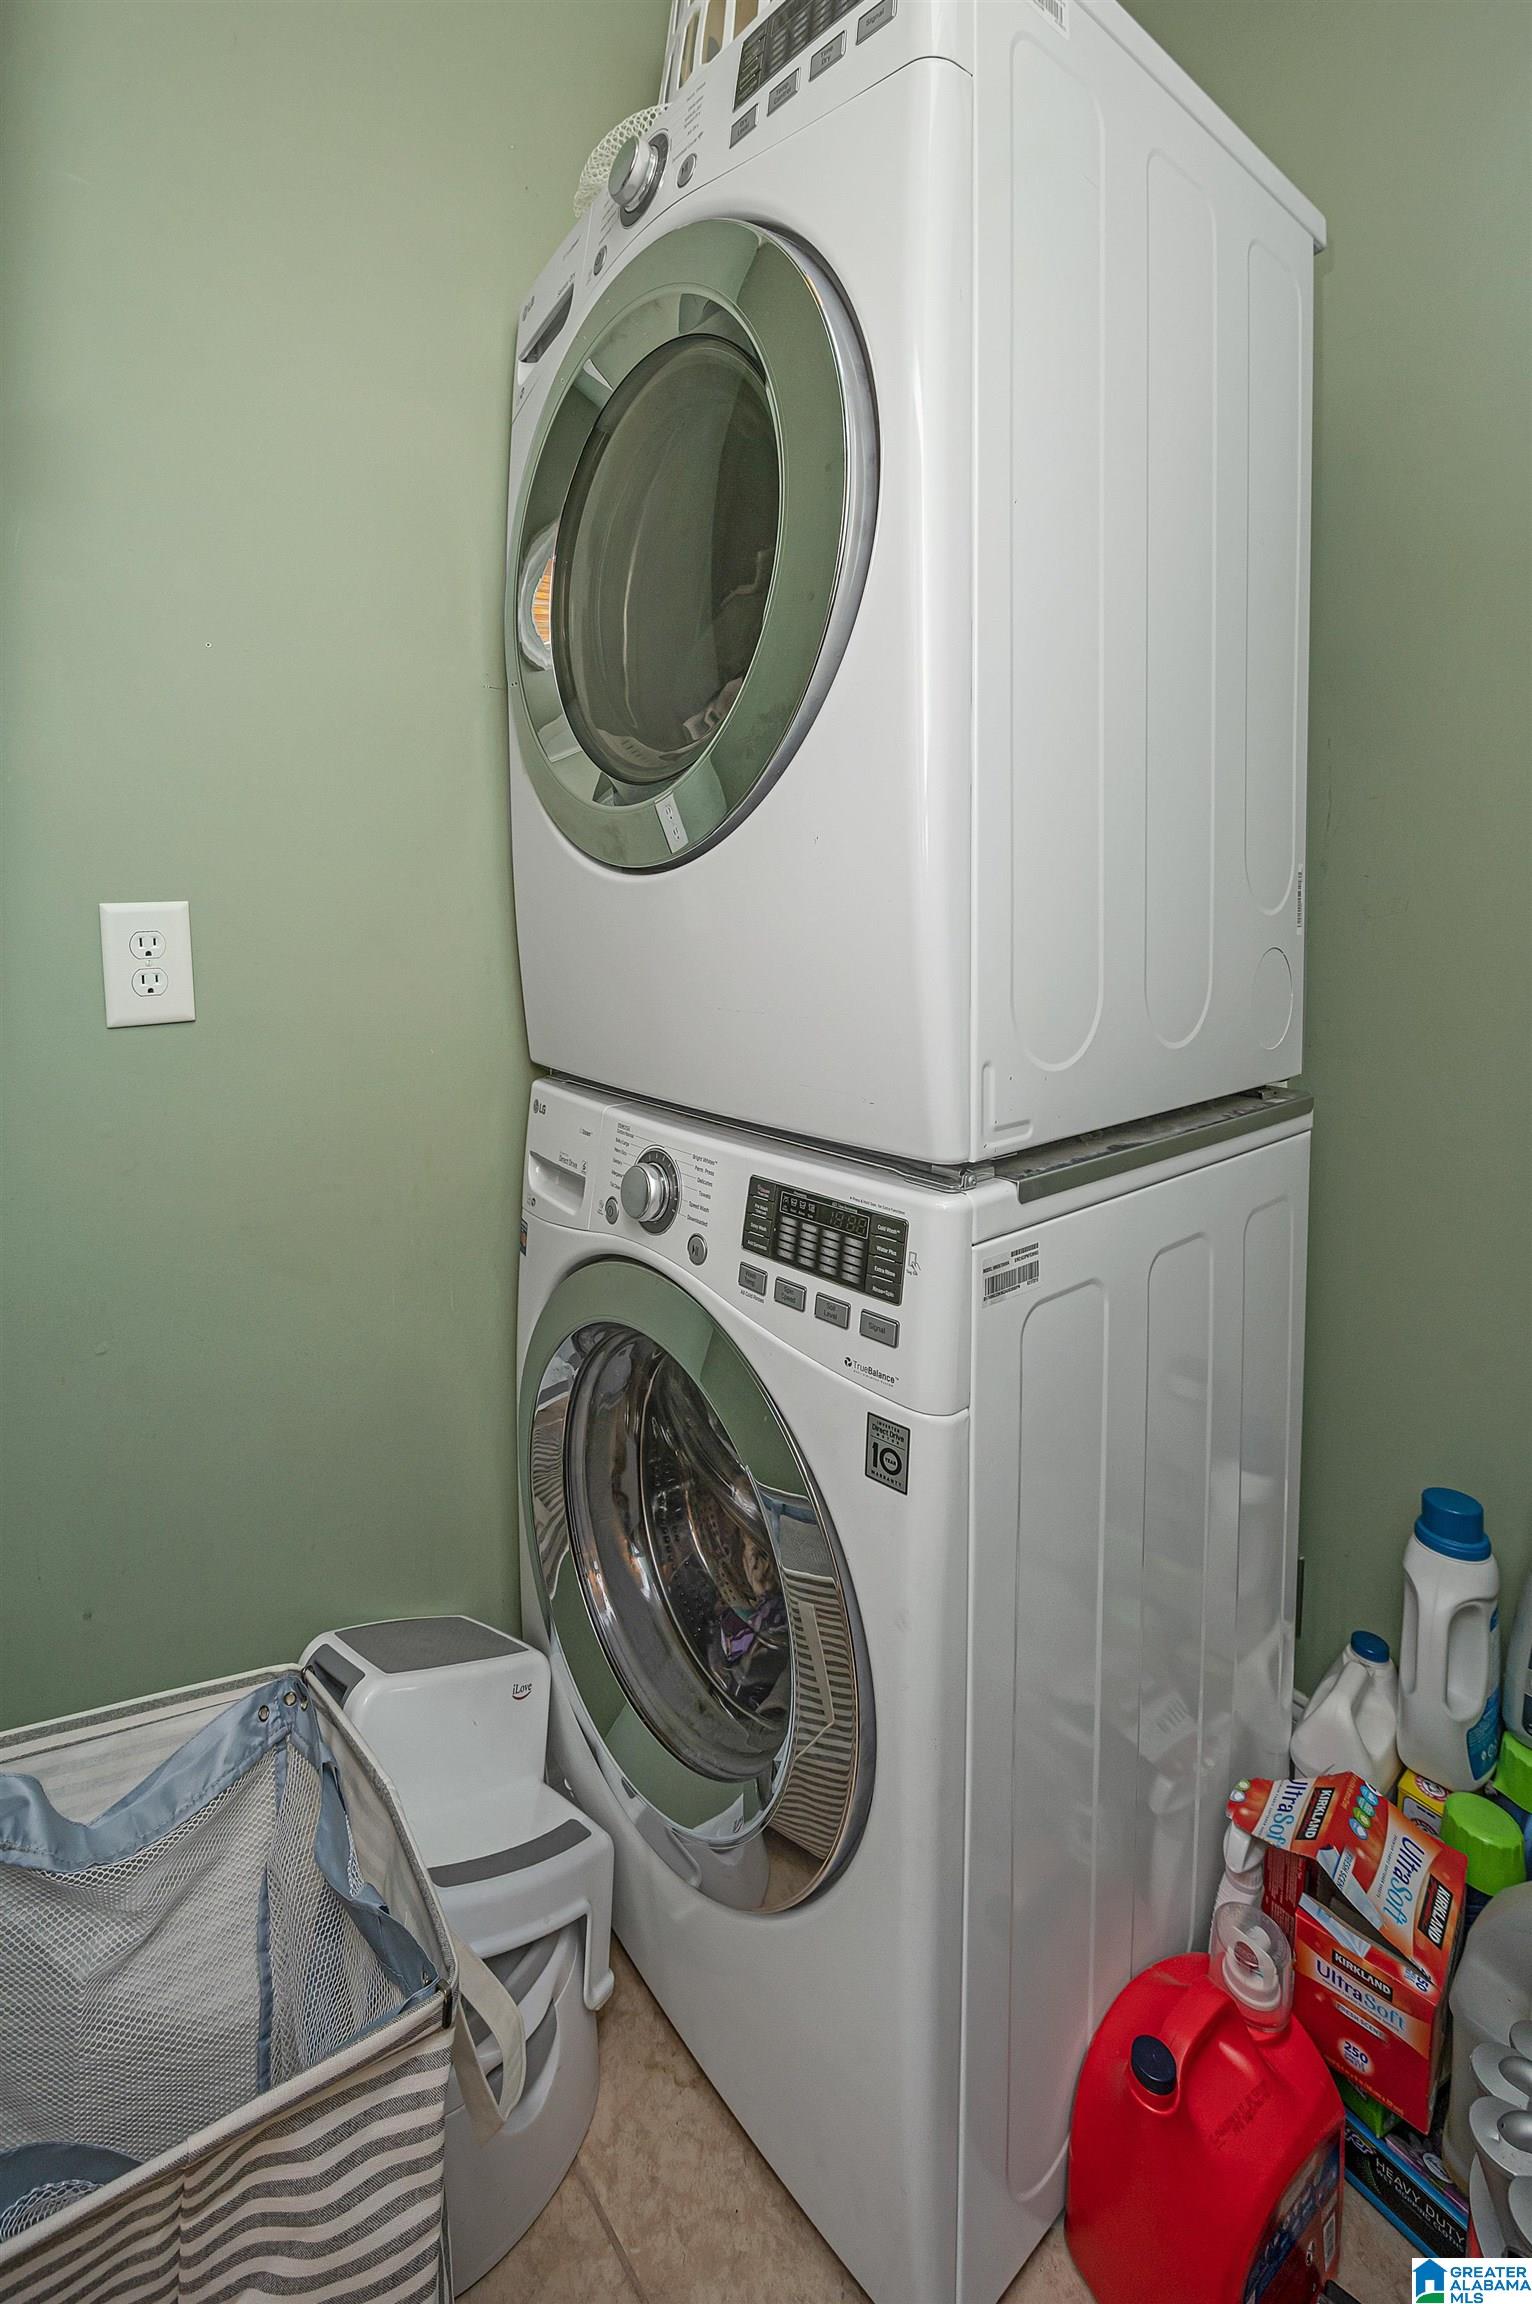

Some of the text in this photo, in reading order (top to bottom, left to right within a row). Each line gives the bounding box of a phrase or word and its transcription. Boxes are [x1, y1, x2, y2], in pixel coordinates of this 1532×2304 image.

[823, 1310, 838, 1320] Level
[868, 1322, 886, 1334] Signal
[871, 1423, 905, 1443] Direct Drive
[872, 1441, 903, 1476] 10
[885, 1457, 897, 1466] YEAR
[870, 1469, 902, 1487] WARRANTY
[1304, 1789, 1333, 1839] KIRKLAND
[1382, 1836, 1425, 1926] UltraSoft
[1427, 1885, 1451, 1945] KIRKLAND
[1334, 1952, 1391, 1995] KIRKLAND
[1315, 1959, 1407, 2032] UltraSoft
[1343, 2040, 1369, 2064] 250
[1376, 2157, 1465, 2244] HEAVY DUTY
